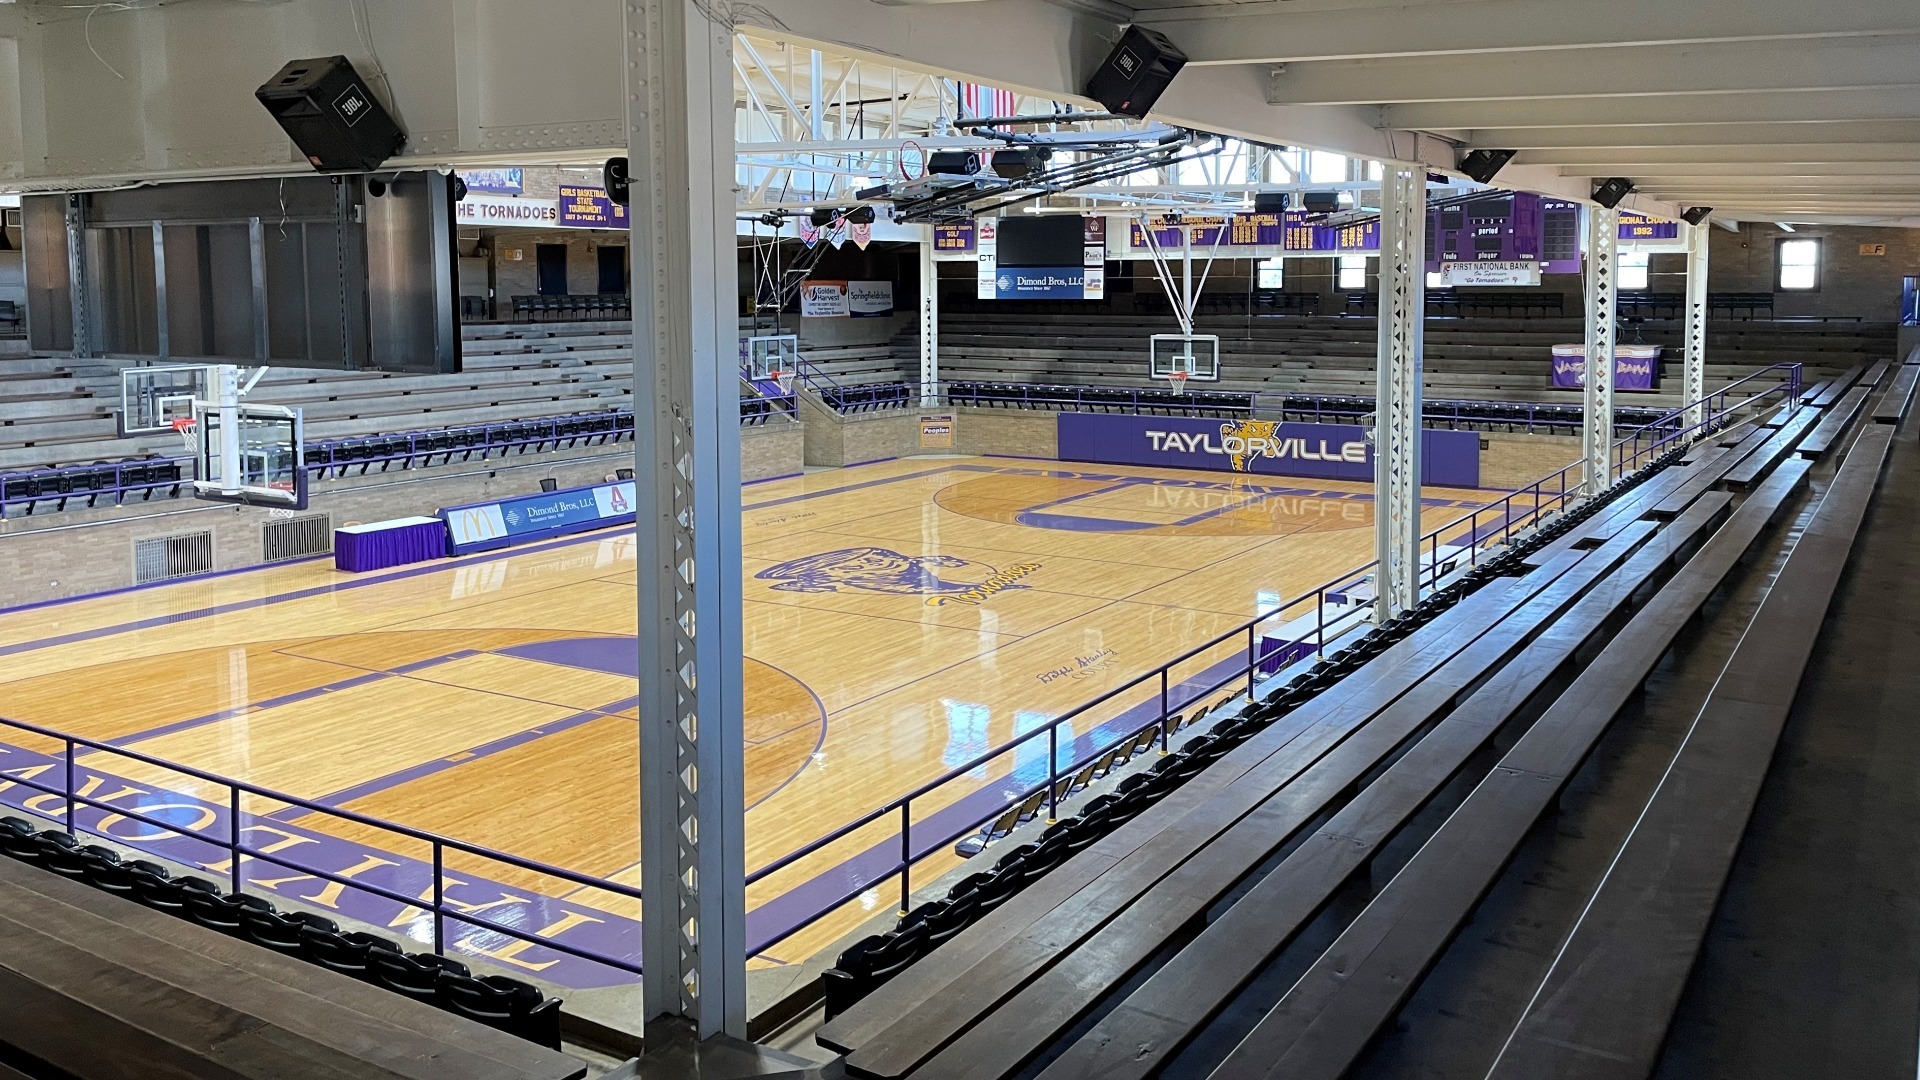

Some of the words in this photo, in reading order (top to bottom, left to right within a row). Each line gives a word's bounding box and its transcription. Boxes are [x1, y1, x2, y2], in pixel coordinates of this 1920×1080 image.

[1120, 53, 1134, 72] JBL
[341, 96, 363, 116] JBL
[561, 188, 576, 196] GIRLS
[577, 197, 593, 205] STATE
[457, 203, 475, 217] HE
[480, 204, 556, 220] TORNADOES
[568, 205, 602, 213] TOURNAMENT
[1618, 216, 1645, 224] GIONAL
[1478, 227, 1499, 236] period
[1633, 227, 1653, 236] 1992
[1874, 245, 1883, 254] F
[1478, 252, 1498, 260] player
[1453, 262, 1472, 271] FIRST
[1473, 262, 1509, 271] NATIONAL
[1509, 262, 1530, 270] BANK
[1017, 275, 1046, 286] Dimond
[1048, 276, 1068, 287] Bros,
[1068, 277, 1084, 286] LLC
[817, 287, 836, 295] Golden
[1145, 430, 1366, 463] TAYLORVILLE
[526, 502, 559, 518] Dimond
[559, 501, 579, 511] Bros,
[579, 497, 595, 508] LLC
